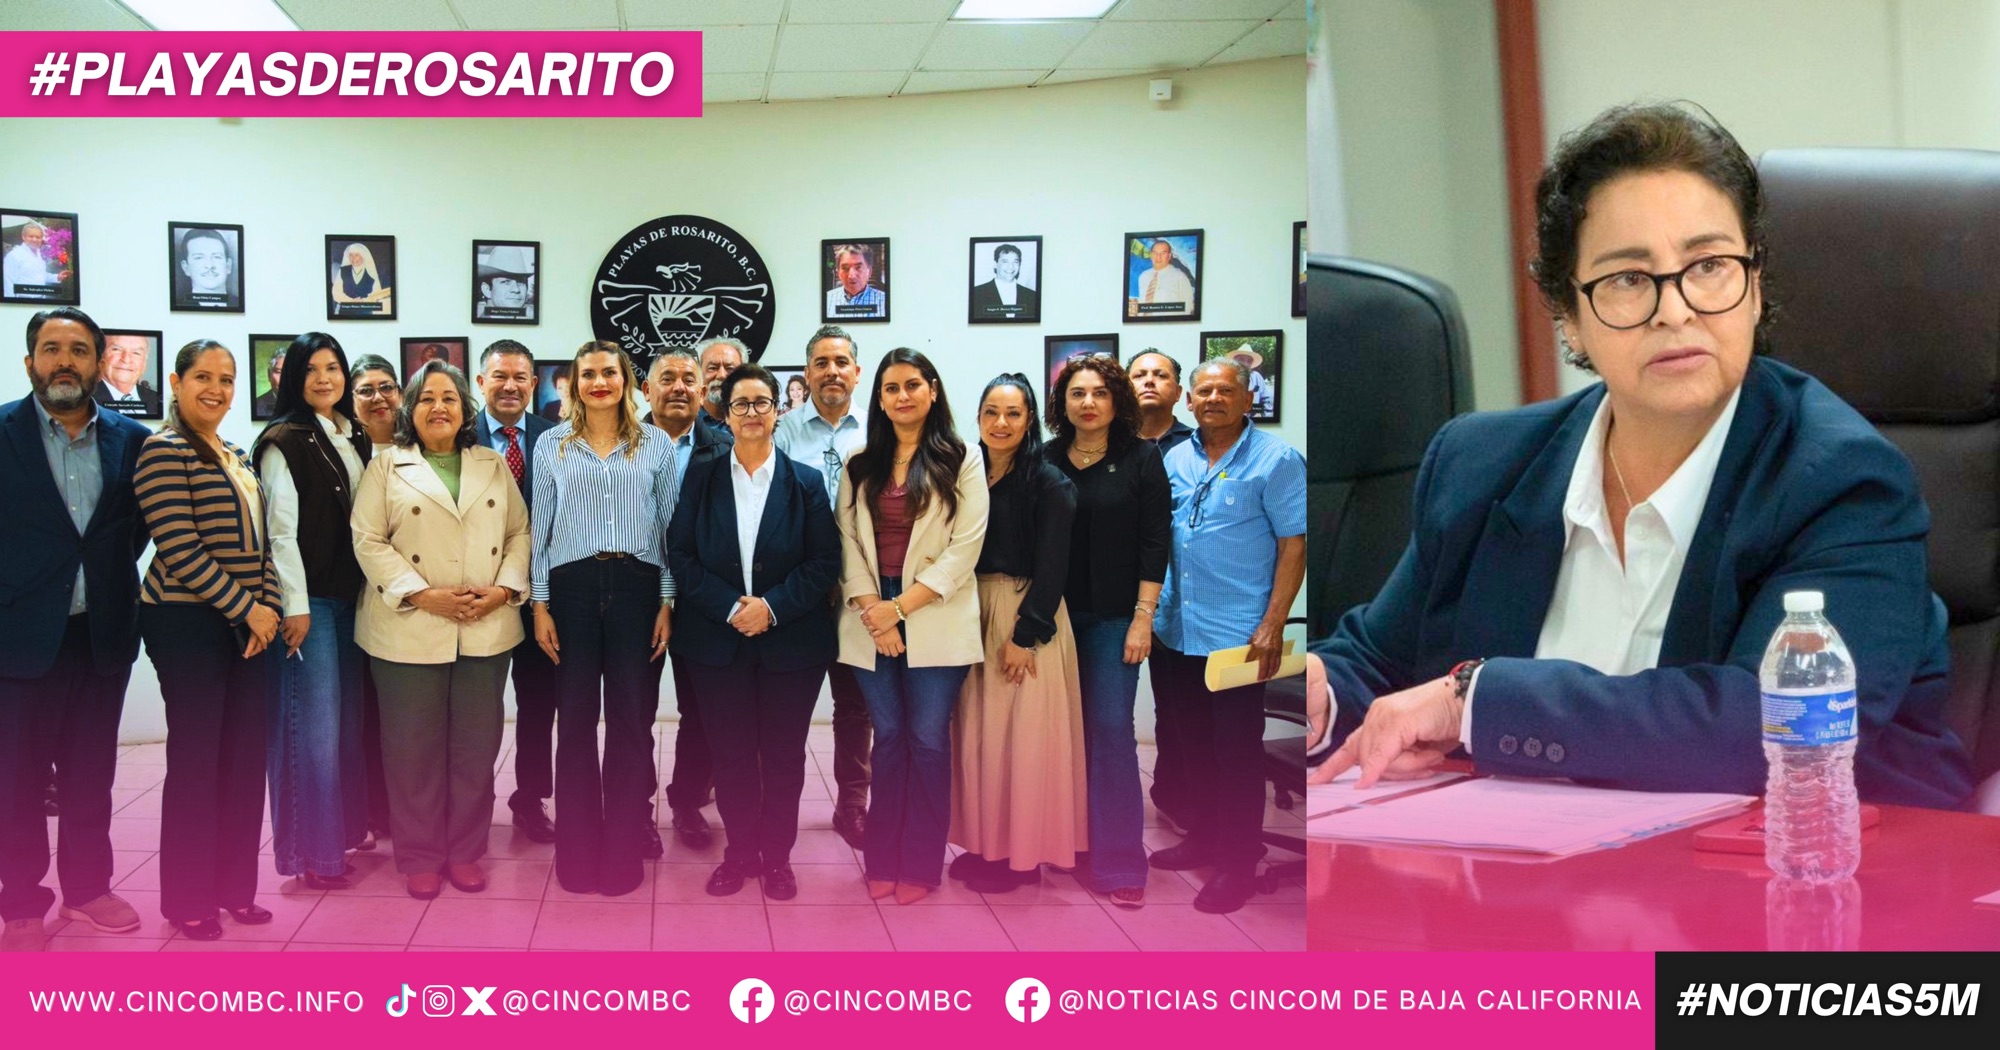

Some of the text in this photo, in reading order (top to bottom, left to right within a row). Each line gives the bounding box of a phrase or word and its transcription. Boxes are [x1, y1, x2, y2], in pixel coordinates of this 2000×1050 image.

[608, 225, 757, 282] PLAYAS DE ROSARITO, B.C.
